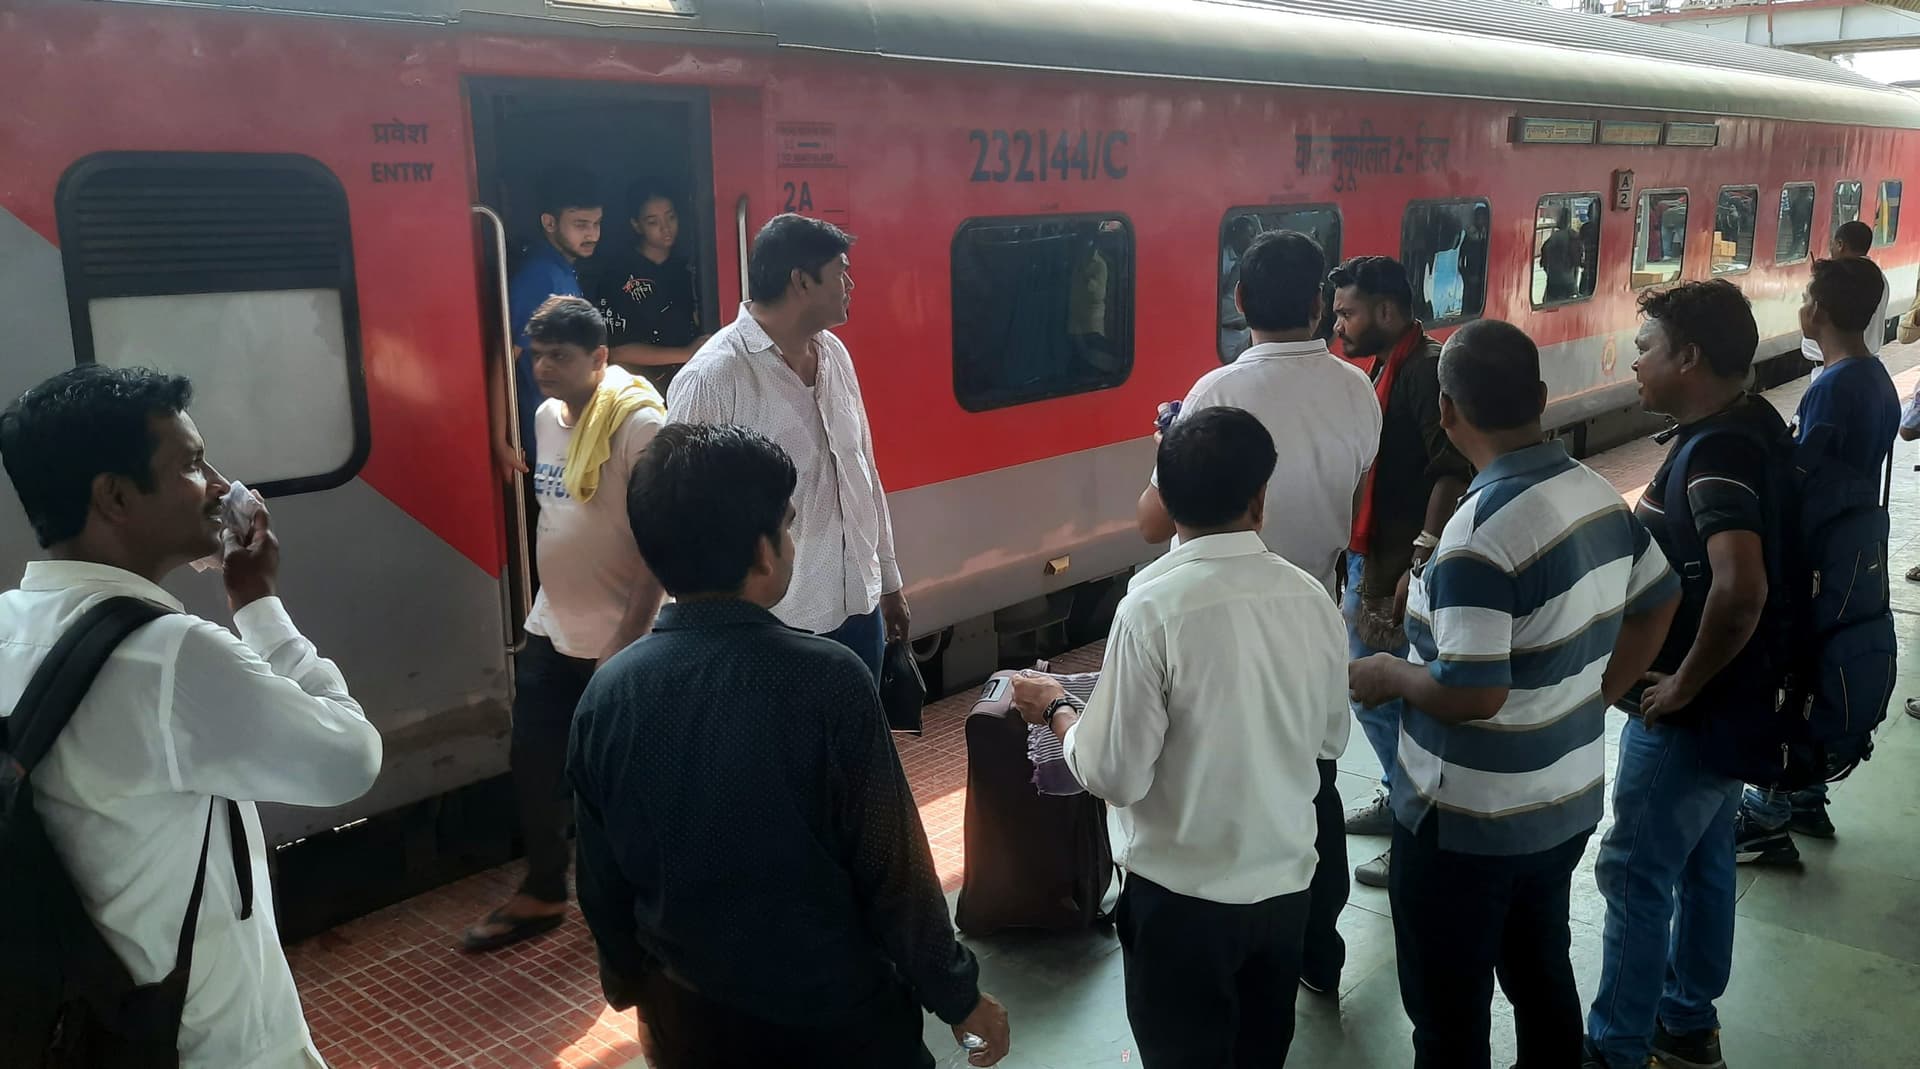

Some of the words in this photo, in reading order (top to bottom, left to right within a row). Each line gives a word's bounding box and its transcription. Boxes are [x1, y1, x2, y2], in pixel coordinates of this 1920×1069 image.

[371, 116, 430, 144] प्रवेश
[969, 128, 1130, 182] 232144/C
[371, 161, 434, 183] ENTRY
[783, 181, 814, 212] 2A
